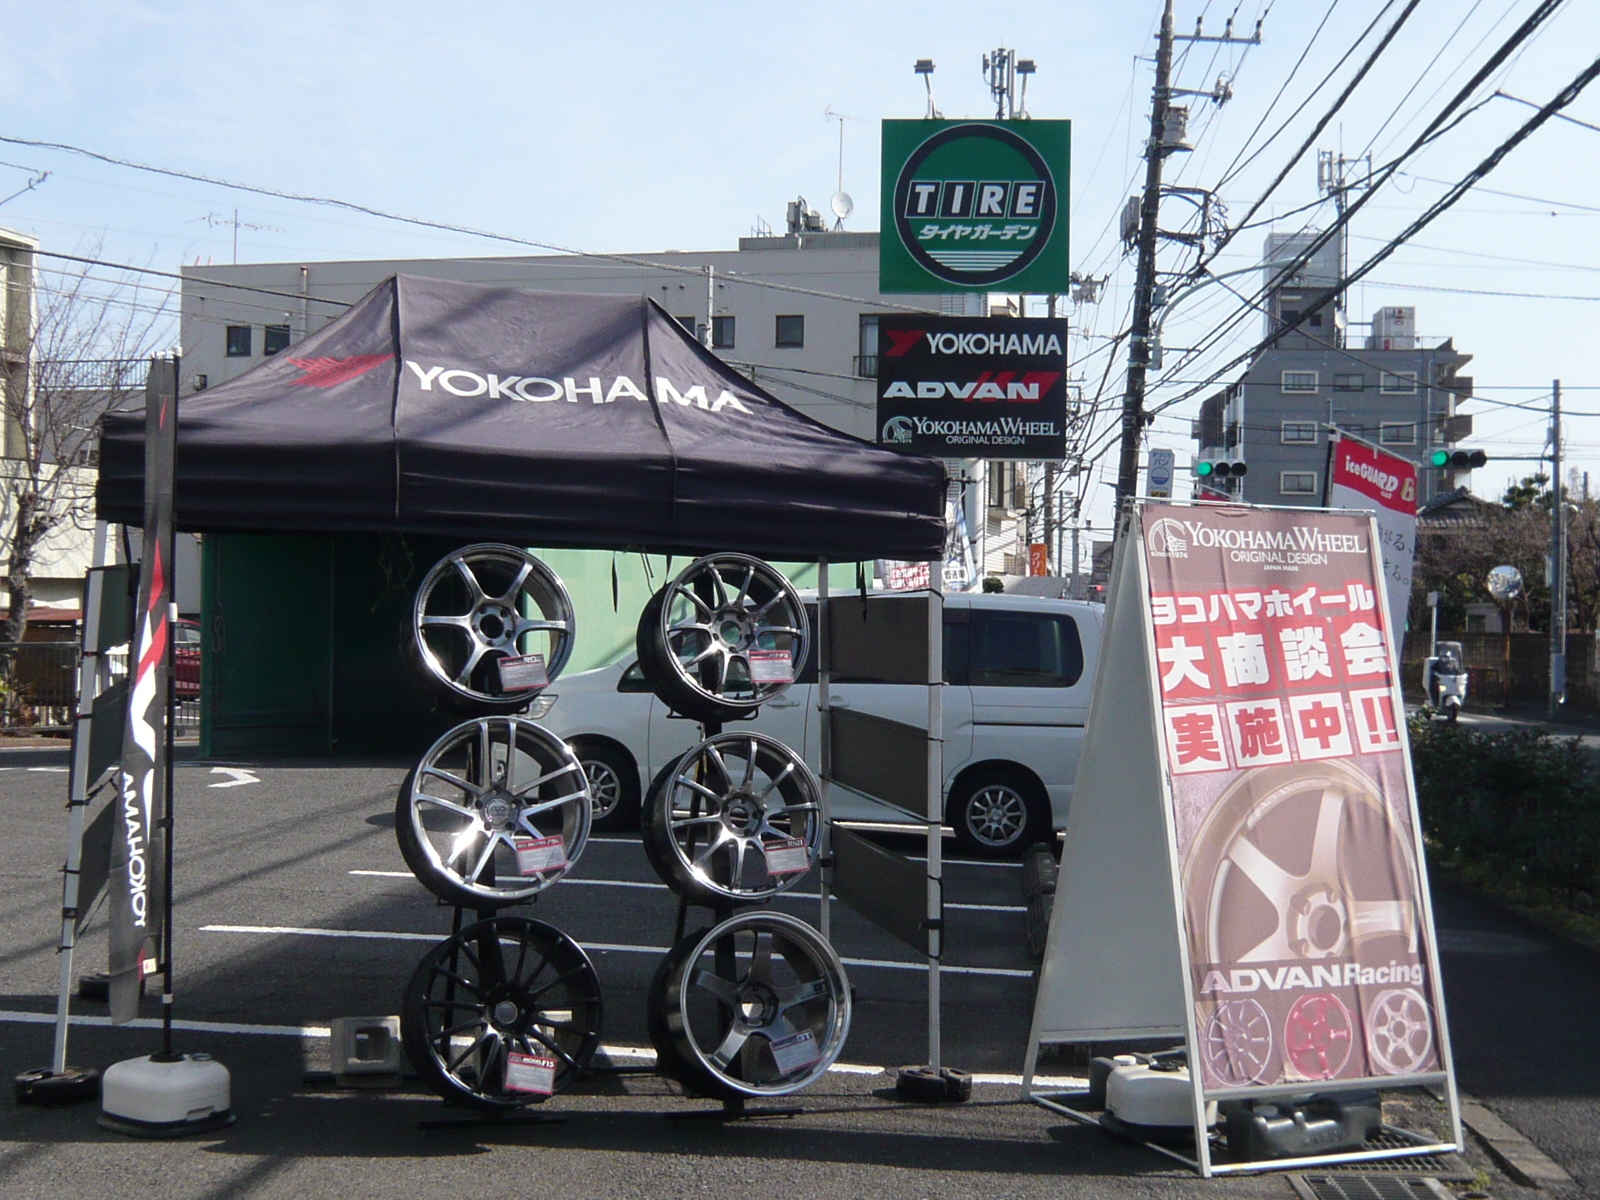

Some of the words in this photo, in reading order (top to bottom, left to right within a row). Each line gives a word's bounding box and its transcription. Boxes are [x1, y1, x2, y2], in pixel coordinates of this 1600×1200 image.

[914, 184, 1042, 215] TIRE
[918, 224, 1038, 241] タイヤガーデン
[925, 332, 1063, 356] YOKOHAMA
[406, 360, 754, 415] YOKOHAMA
[882, 380, 1040, 400] ADVAN
[912, 416, 1000, 435] YOKOHAMA
[1000, 417, 1060, 436] WHEEL
[945, 435, 990, 445] ORIGINAL
[991, 435, 1025, 445] DESIGN
[1345, 455, 1399, 492] iceGUARD
[1401, 477, 1415, 502] 6
[1183, 520, 1294, 550] YOKOHAMA
[1292, 526, 1368, 554] WHEEL
[1230, 550, 1285, 564] ORIGINAL
[1287, 551, 1328, 565] DESIGN
[1151, 583, 1376, 625] ヨコハマホイール
[1157, 621, 1391, 691] 大商談会
[1171, 694, 1400, 765] 実施中!!
[1200, 963, 1344, 994] ADVAN
[1343, 960, 1425, 987] Racing
